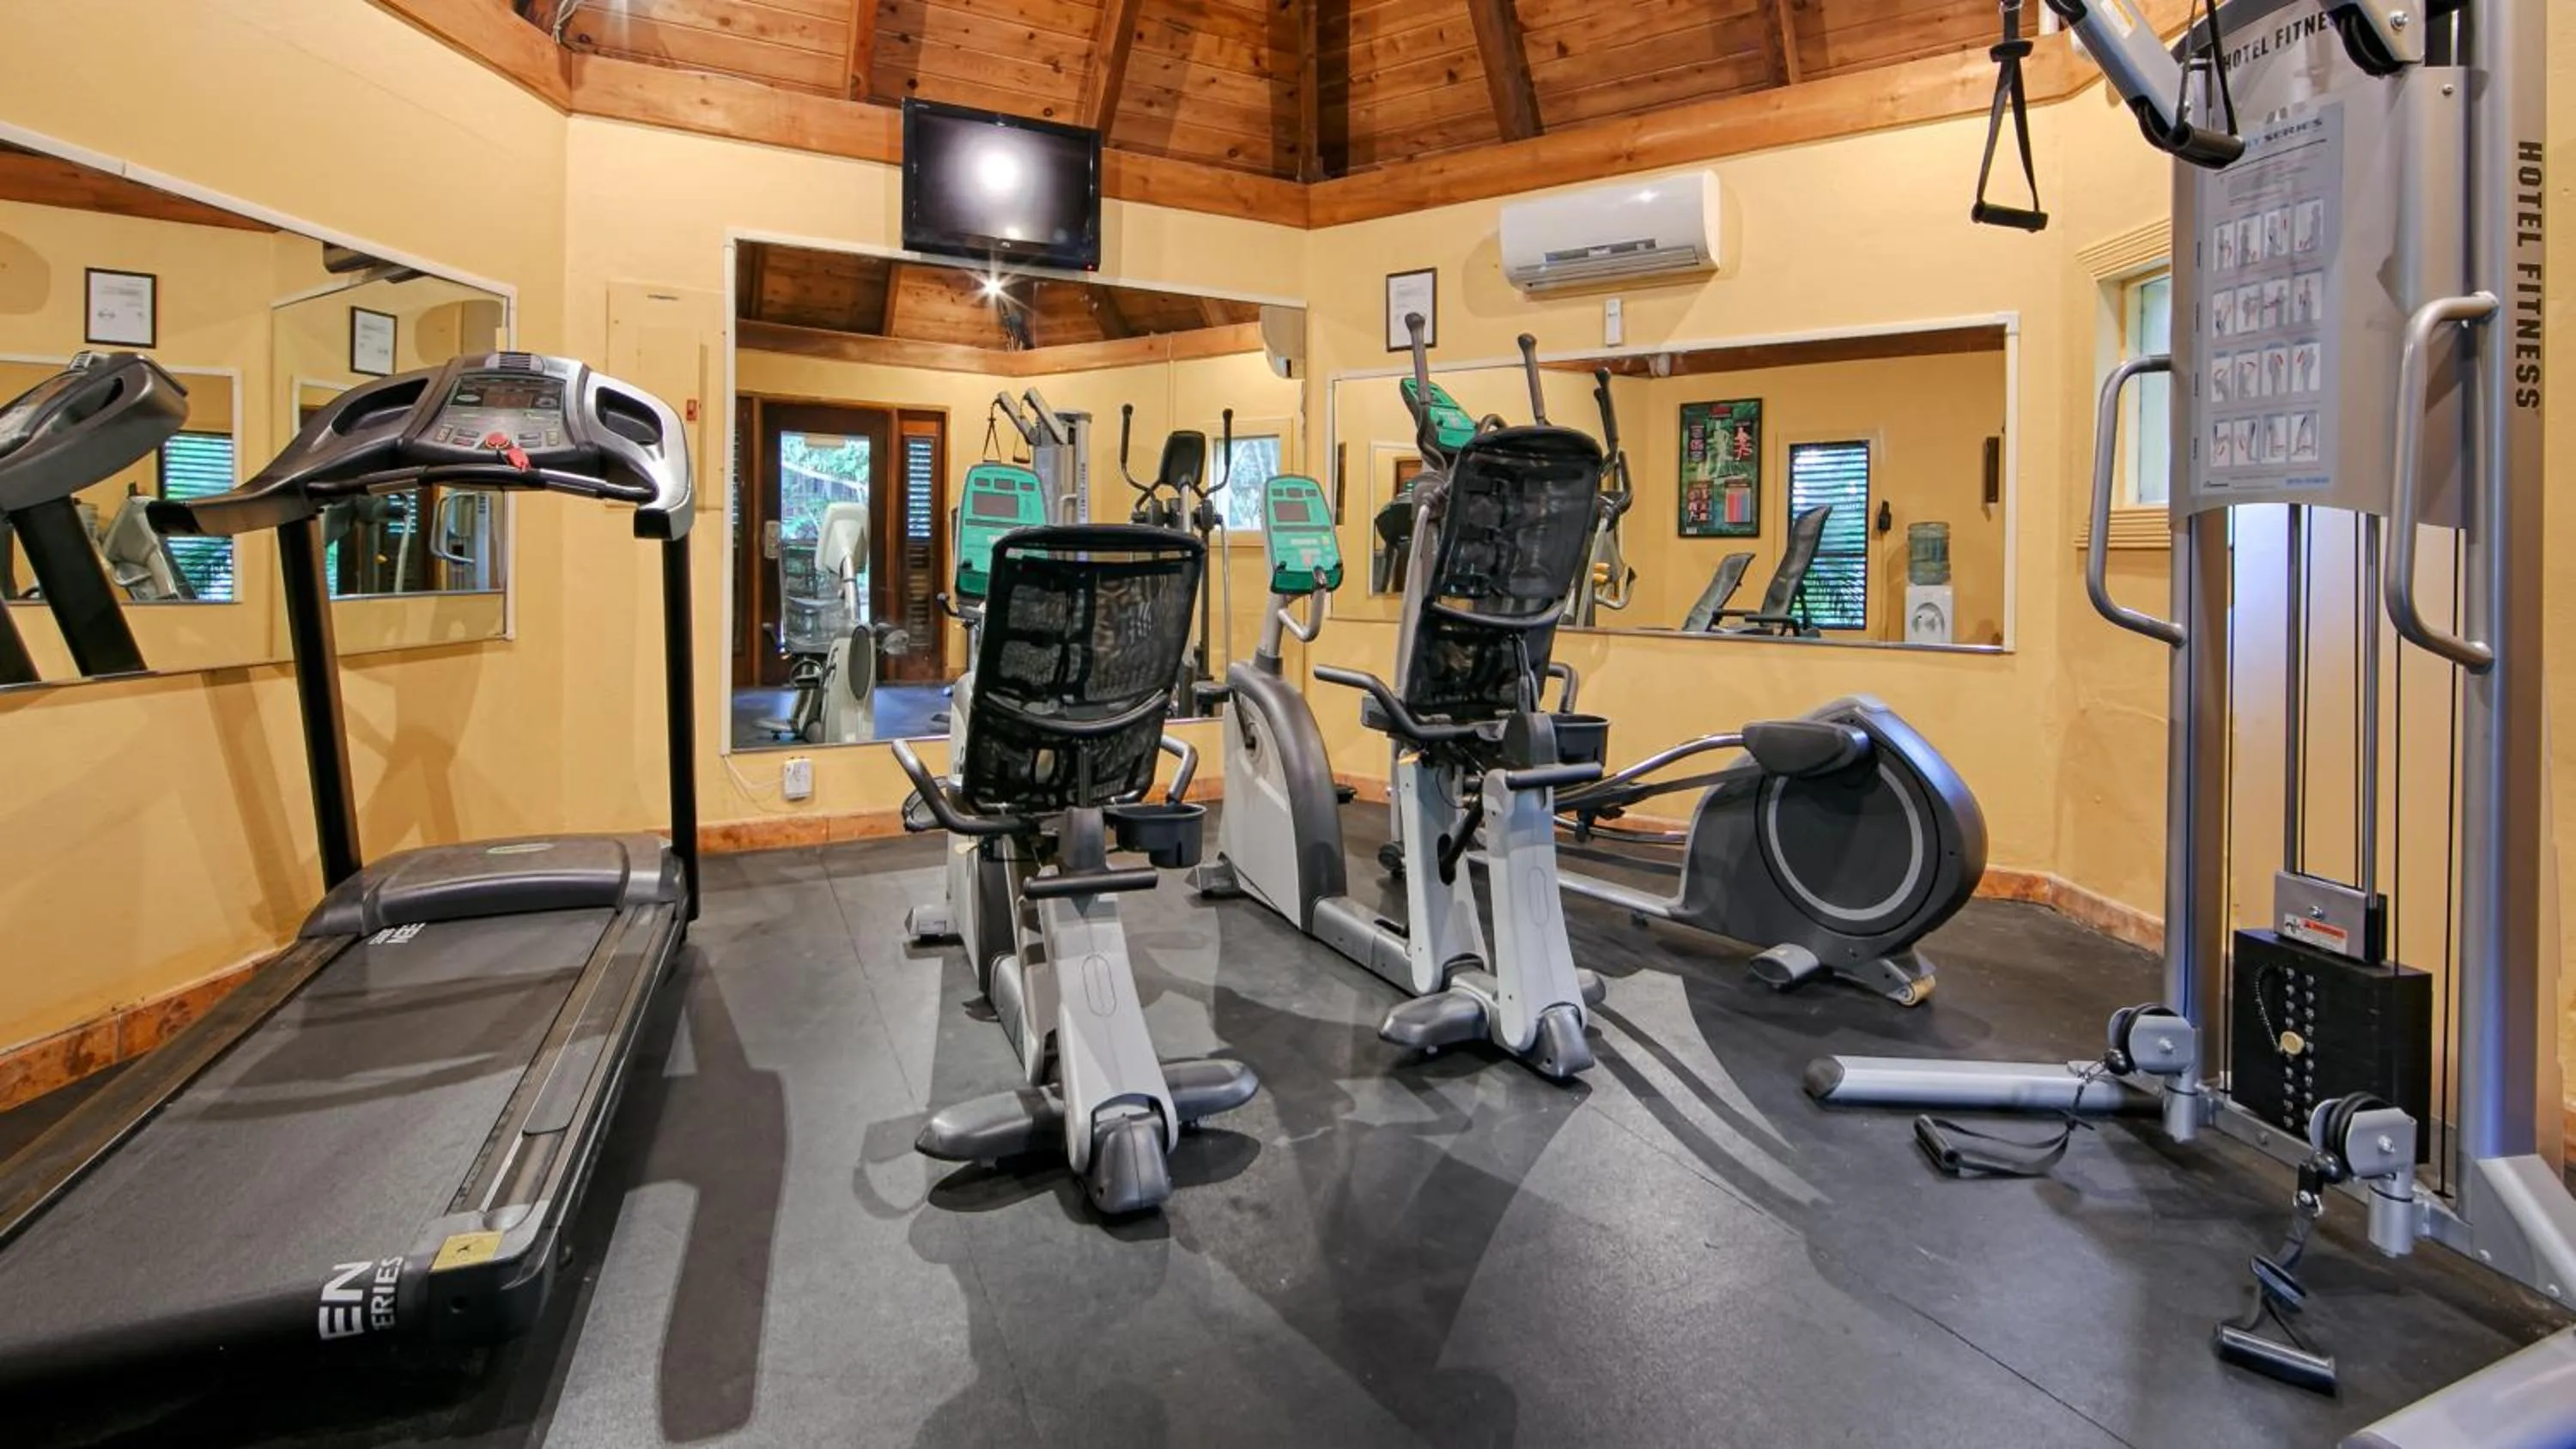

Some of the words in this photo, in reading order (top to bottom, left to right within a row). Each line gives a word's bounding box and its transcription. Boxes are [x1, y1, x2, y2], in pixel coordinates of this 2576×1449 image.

[2223, 35, 2269, 71] HOTEL
[2275, 11, 2328, 49] FITNE
[2517, 142, 2543, 247] HOTEL
[2515, 263, 2542, 409] FITNESS
